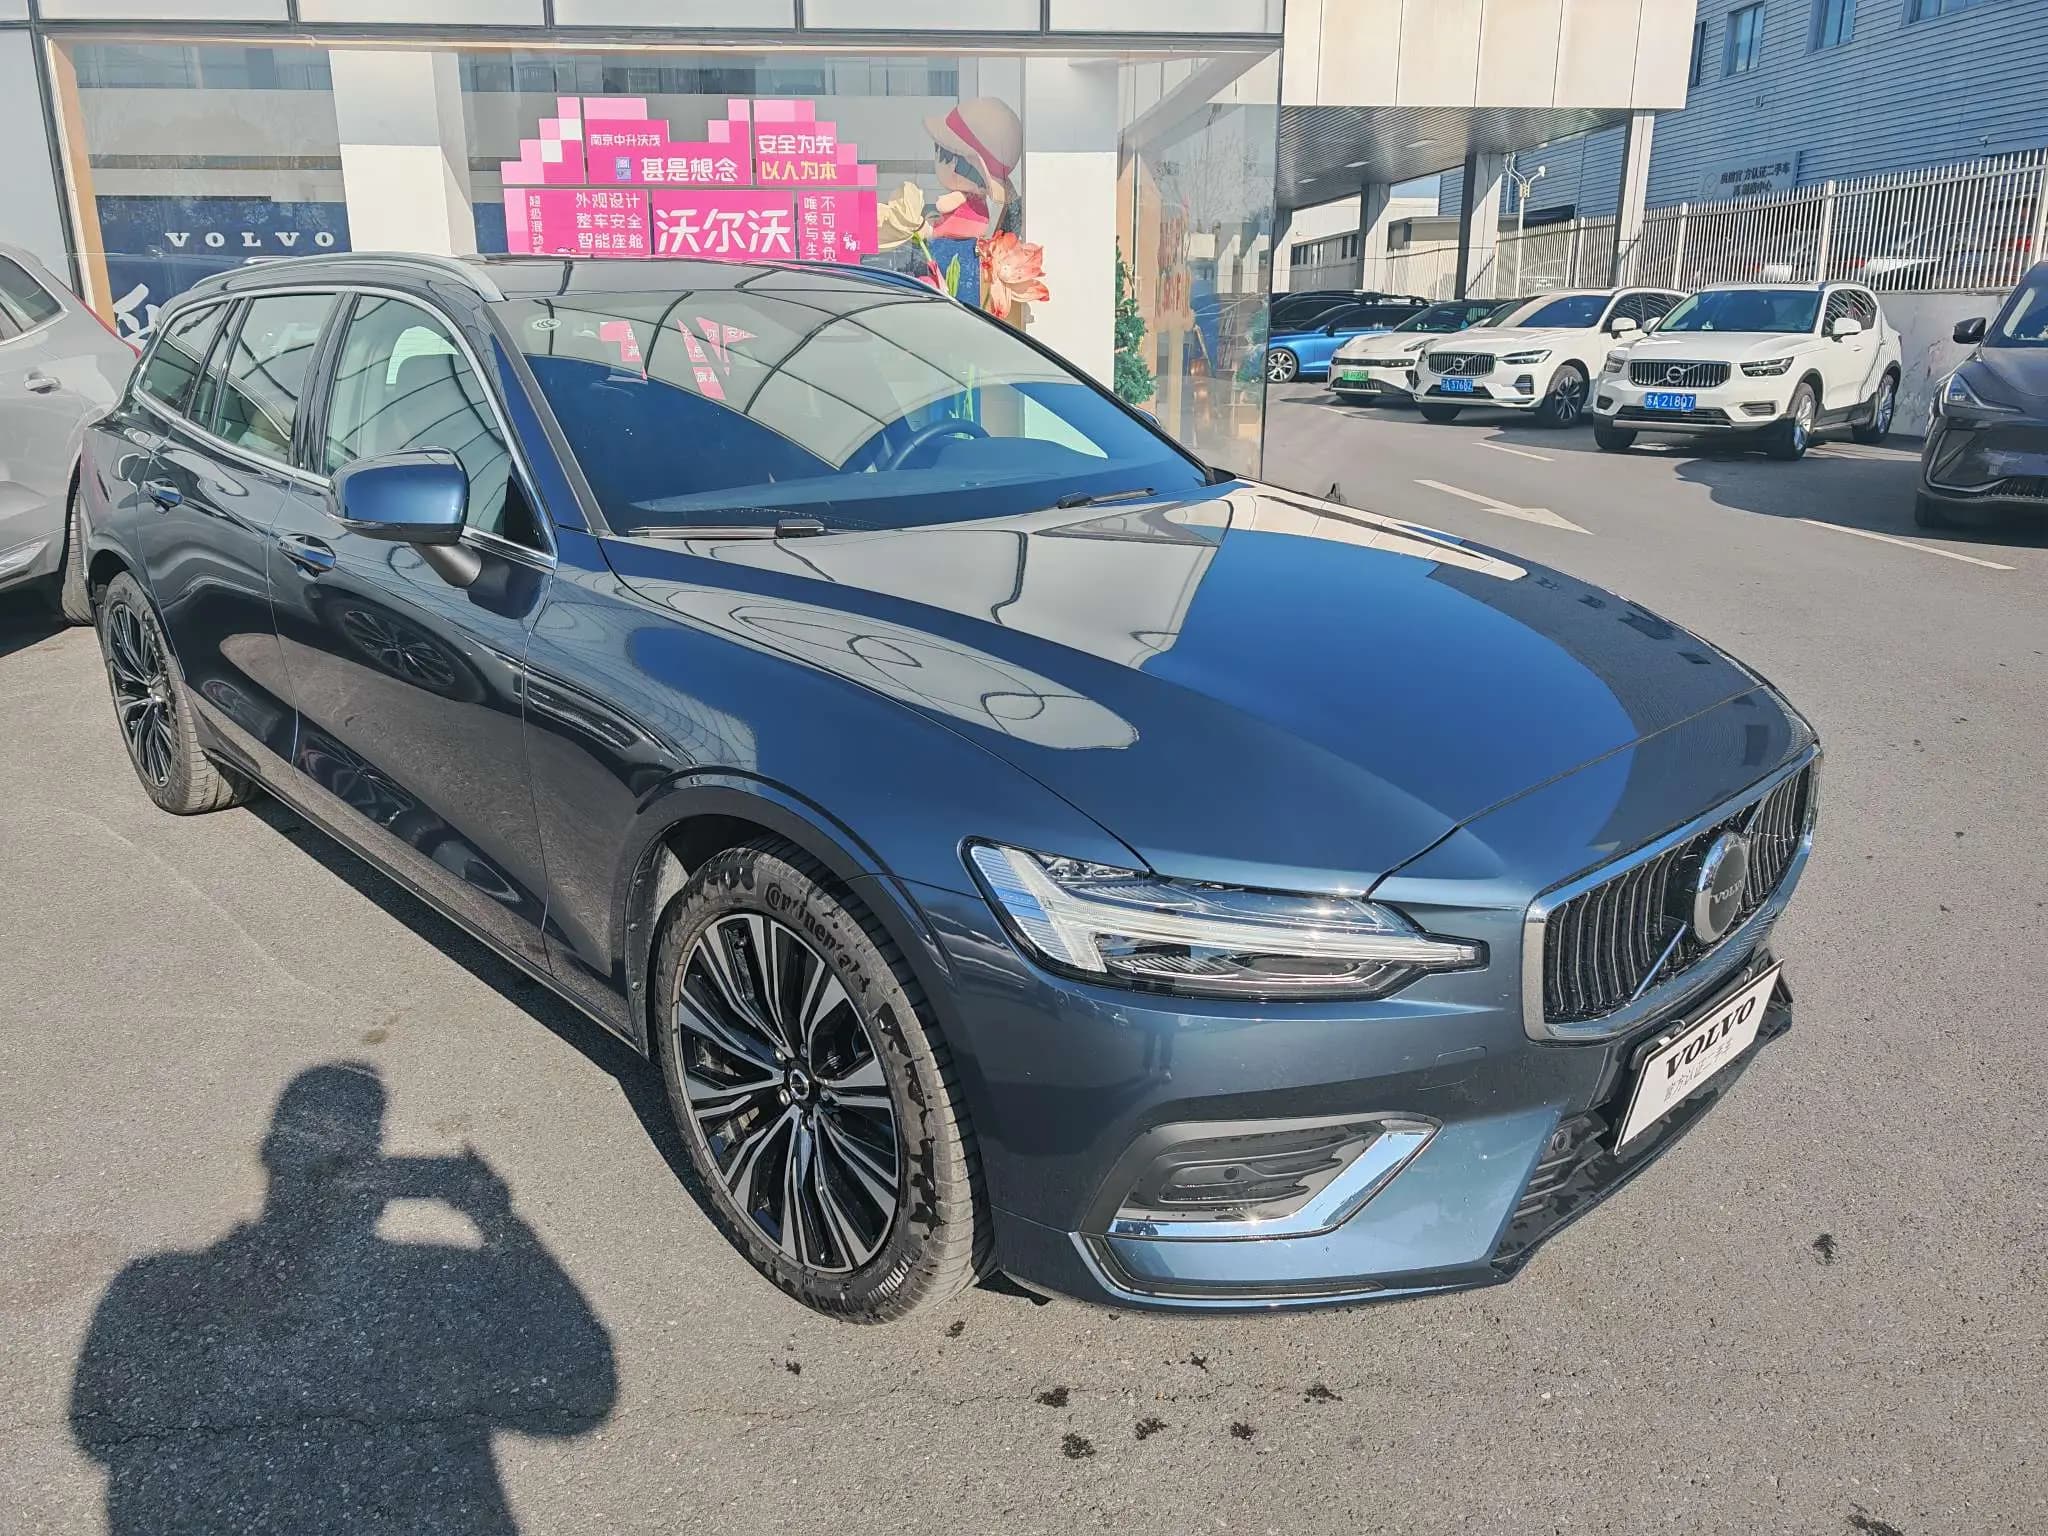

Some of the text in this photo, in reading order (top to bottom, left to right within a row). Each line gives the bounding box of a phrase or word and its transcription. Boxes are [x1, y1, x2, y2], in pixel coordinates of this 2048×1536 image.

[590, 133, 661, 147] 南京中升沃茂
[758, 134, 834, 154] 安全为先
[641, 157, 738, 182] 甚是想念
[761, 160, 837, 180] 以人为本
[575, 192, 640, 208] 外观设计
[575, 212, 642, 229] 整车安全
[165, 231, 335, 248] VOLVO
[656, 208, 792, 253] 沃尔沃
[577, 232, 643, 249] 智能座舱
[1666, 996, 1756, 1079] VOLVO
